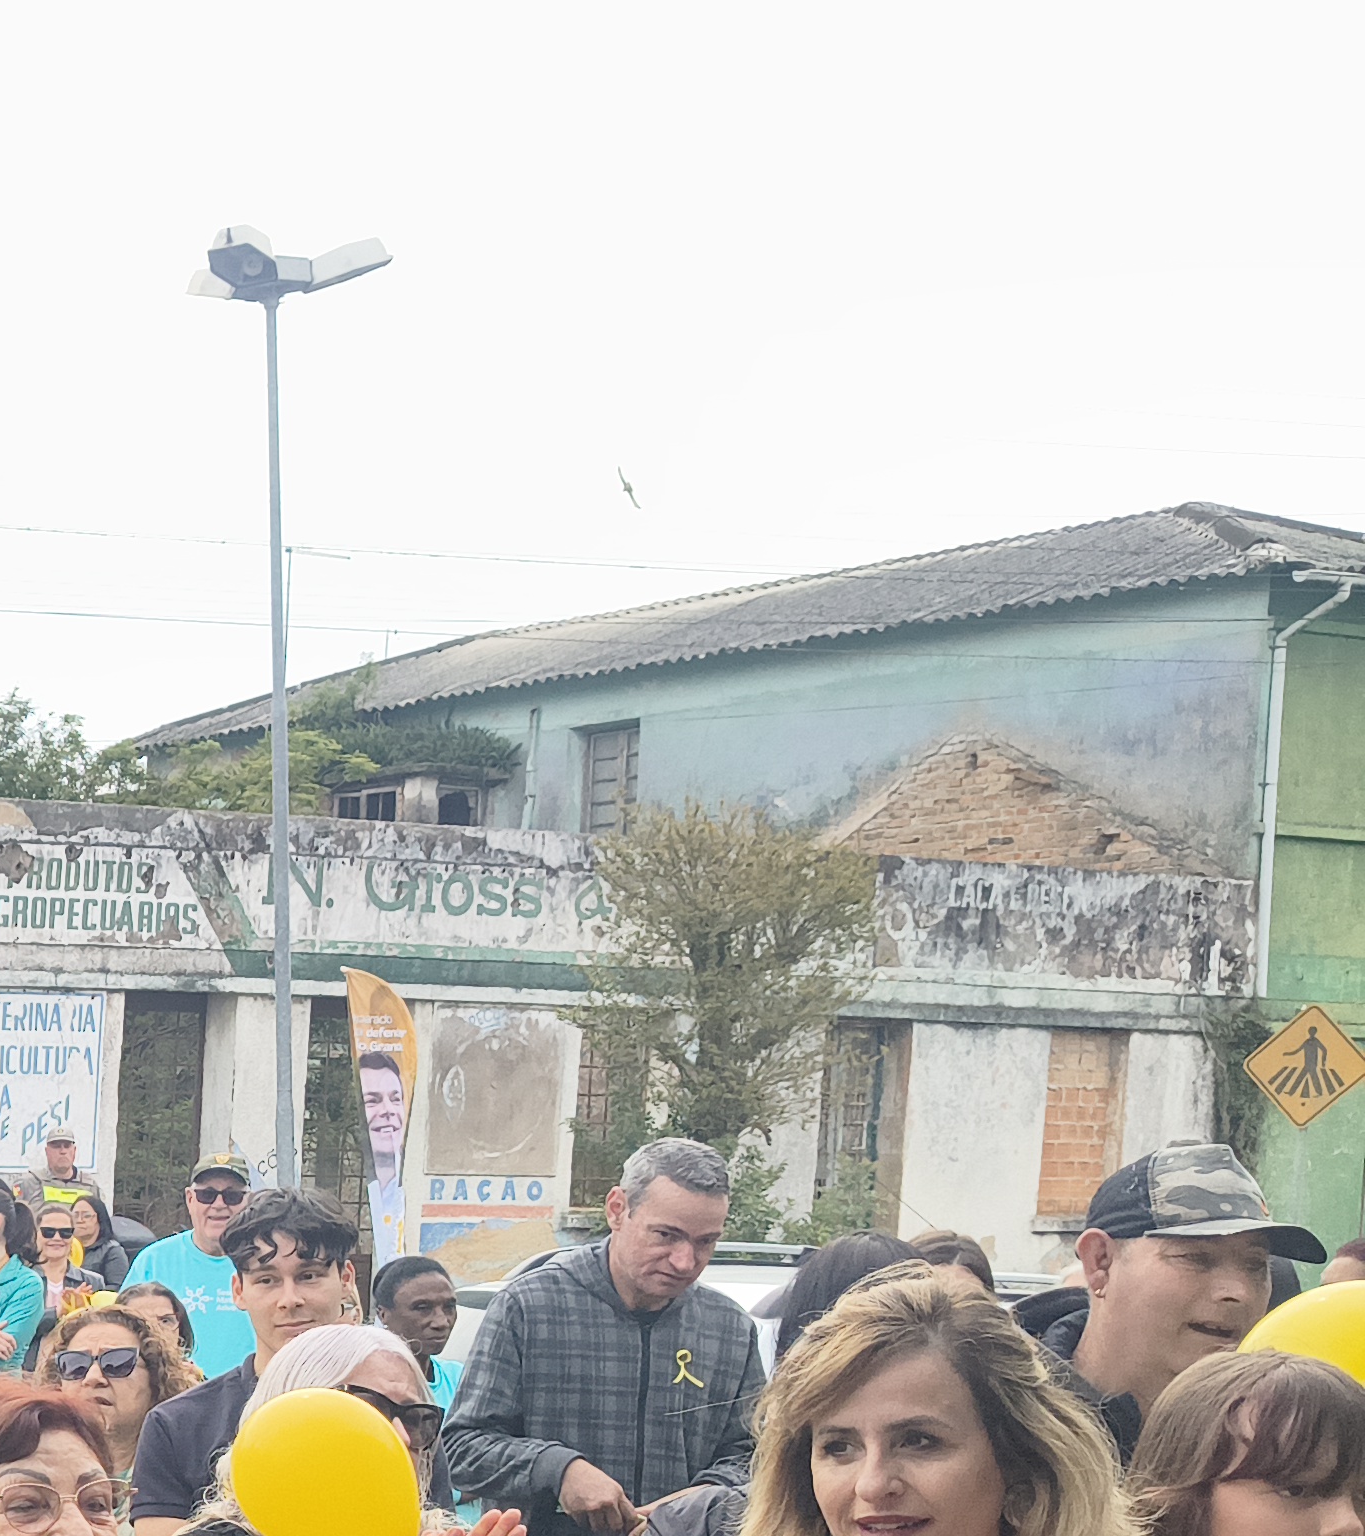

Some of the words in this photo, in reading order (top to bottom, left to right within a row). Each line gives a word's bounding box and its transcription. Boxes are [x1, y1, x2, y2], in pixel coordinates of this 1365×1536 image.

[6, 856, 156, 894] RODUTOS
[365, 856, 546, 919] Gross
[429, 1176, 544, 1203] RAÇÃO
